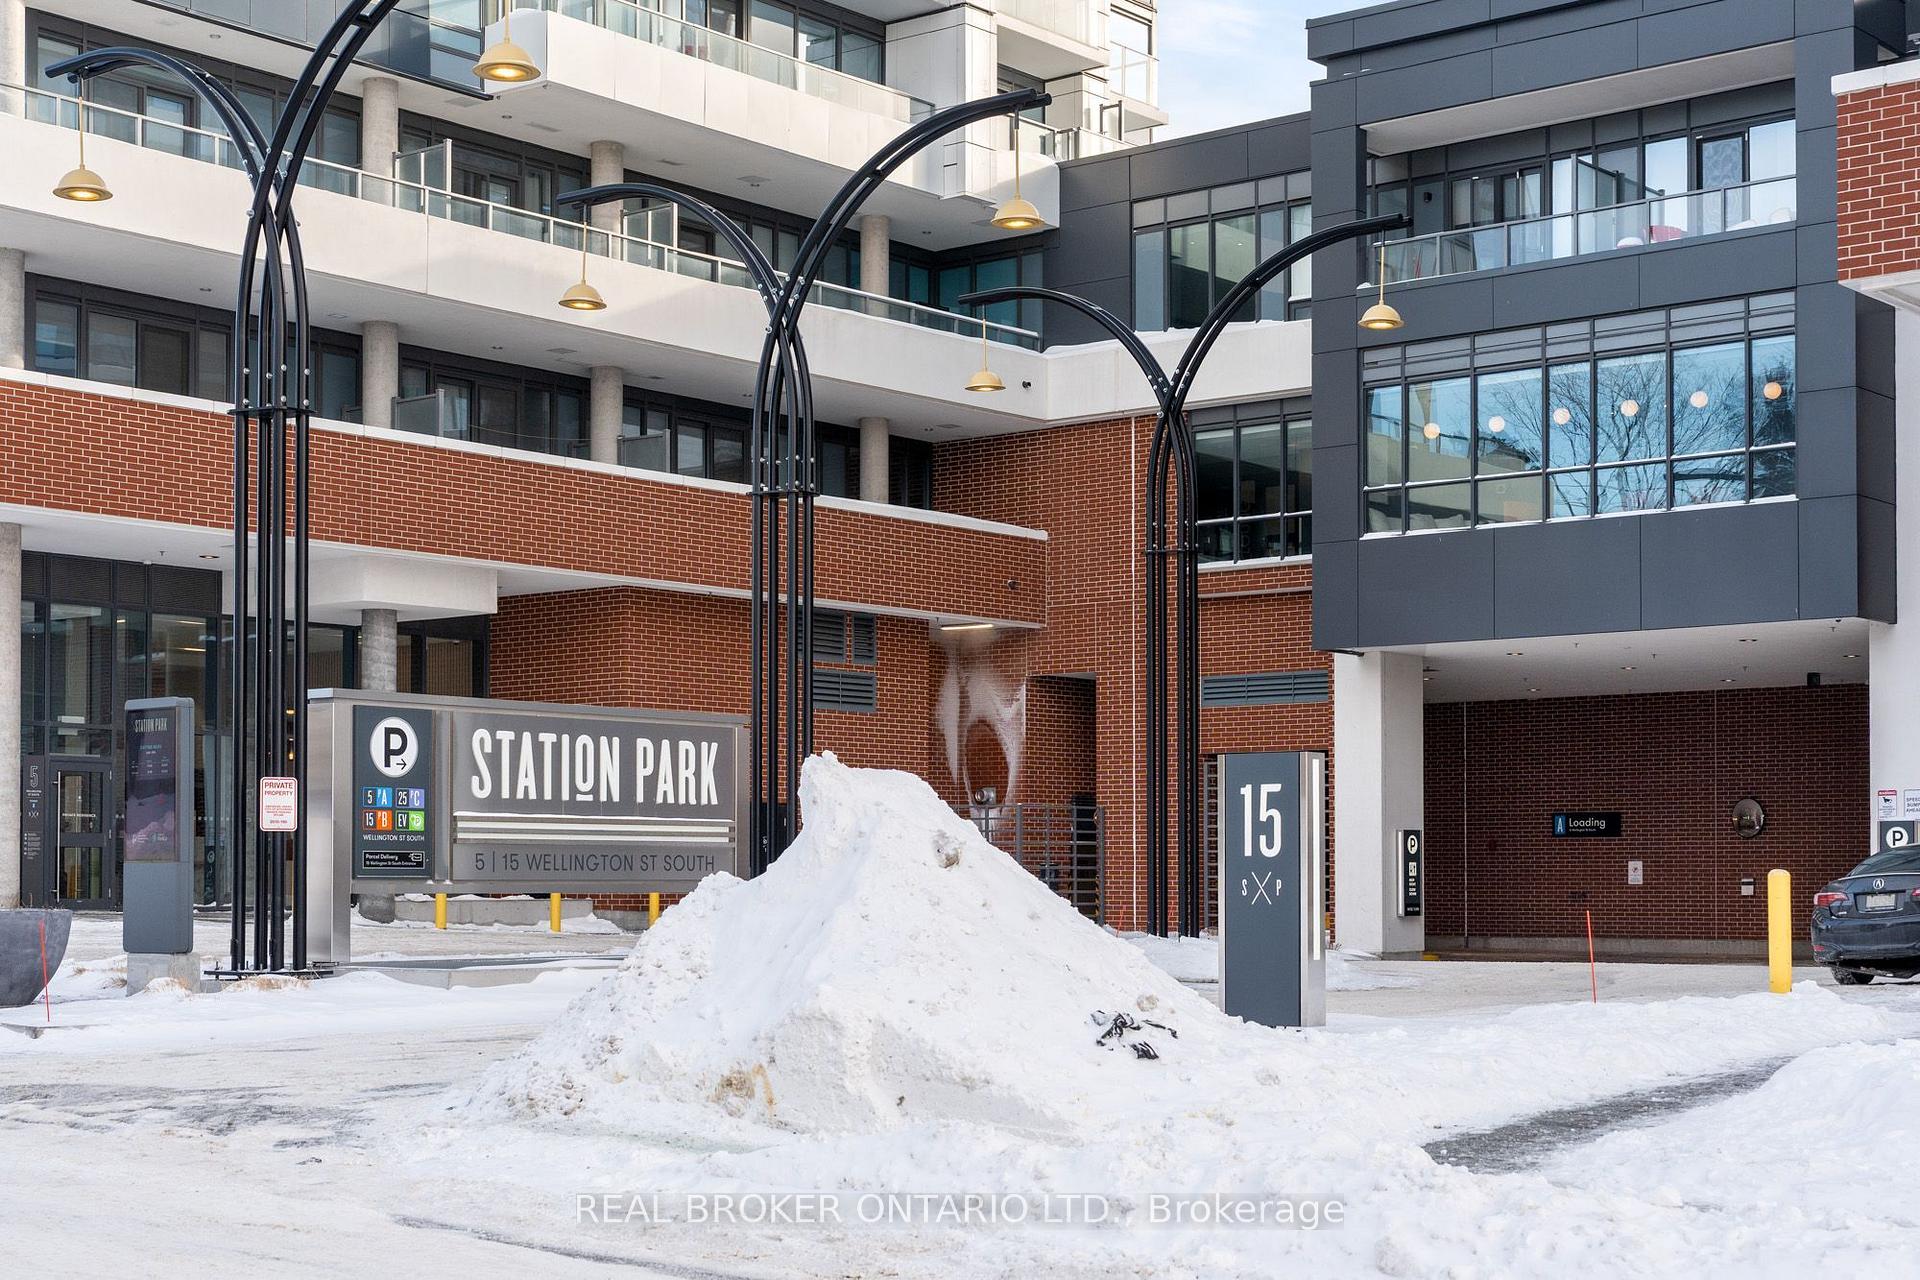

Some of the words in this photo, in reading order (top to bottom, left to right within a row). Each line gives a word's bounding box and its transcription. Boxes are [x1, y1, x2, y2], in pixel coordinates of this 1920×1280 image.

[384, 727, 408, 768] P
[471, 728, 620, 802] STATION
[636, 738, 718, 805] PARK
[30, 766, 38, 788] 5
[368, 790, 373, 804] 5
[398, 792, 407, 805] 25
[366, 813, 374, 826] 15
[398, 814, 407, 827] EV
[1240, 784, 1282, 857] 15
[1558, 818, 1563, 832] A
[1569, 818, 1605, 829] Loading
[1410, 838, 1415, 851] P
[1893, 831, 1903, 846] P
[475, 853, 484, 870] 5
[503, 854, 519, 871] 15
[526, 854, 634, 872] WELLINGTON
[640, 855, 656, 872] ST
[664, 855, 714, 872] SOUTH
